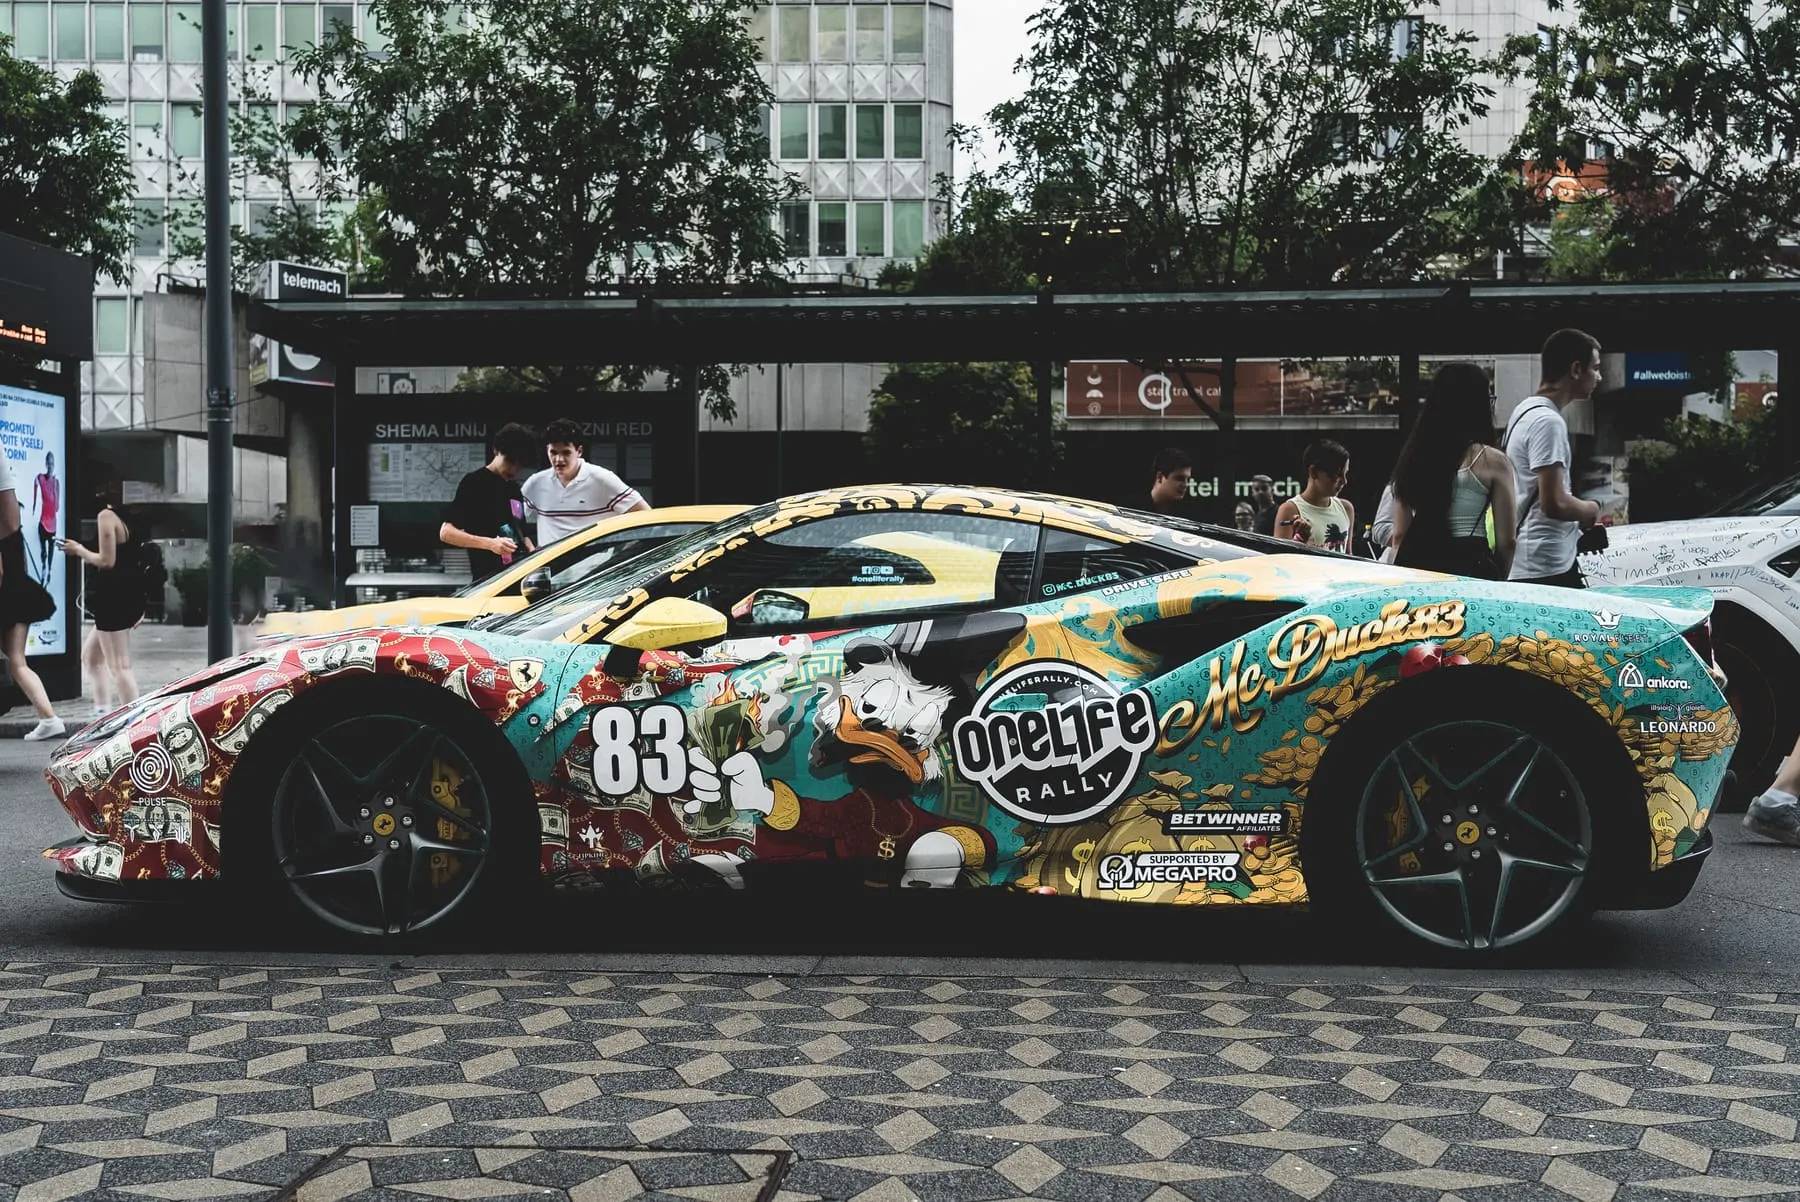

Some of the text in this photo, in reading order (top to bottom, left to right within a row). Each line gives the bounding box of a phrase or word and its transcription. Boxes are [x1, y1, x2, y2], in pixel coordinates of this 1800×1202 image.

[282, 271, 341, 295] telemach
[375, 423, 439, 438] SHEMA
[444, 422, 488, 438] LINIJ
[616, 422, 653, 436] RED
[20, 436, 44, 451] VSELEJ
[1189, 476, 1301, 497] telmch
[851, 575, 905, 584] #oneliferally
[1102, 578, 1150, 597] DRIVE
[1646, 675, 1692, 690] ankora.
[1640, 721, 1717, 733] LEONARDO
[591, 703, 688, 796] 83
[1015, 771, 1114, 804] RALLY
[138, 797, 167, 806] PULSE
[1149, 855, 1227, 864] SUPPORTED BY
